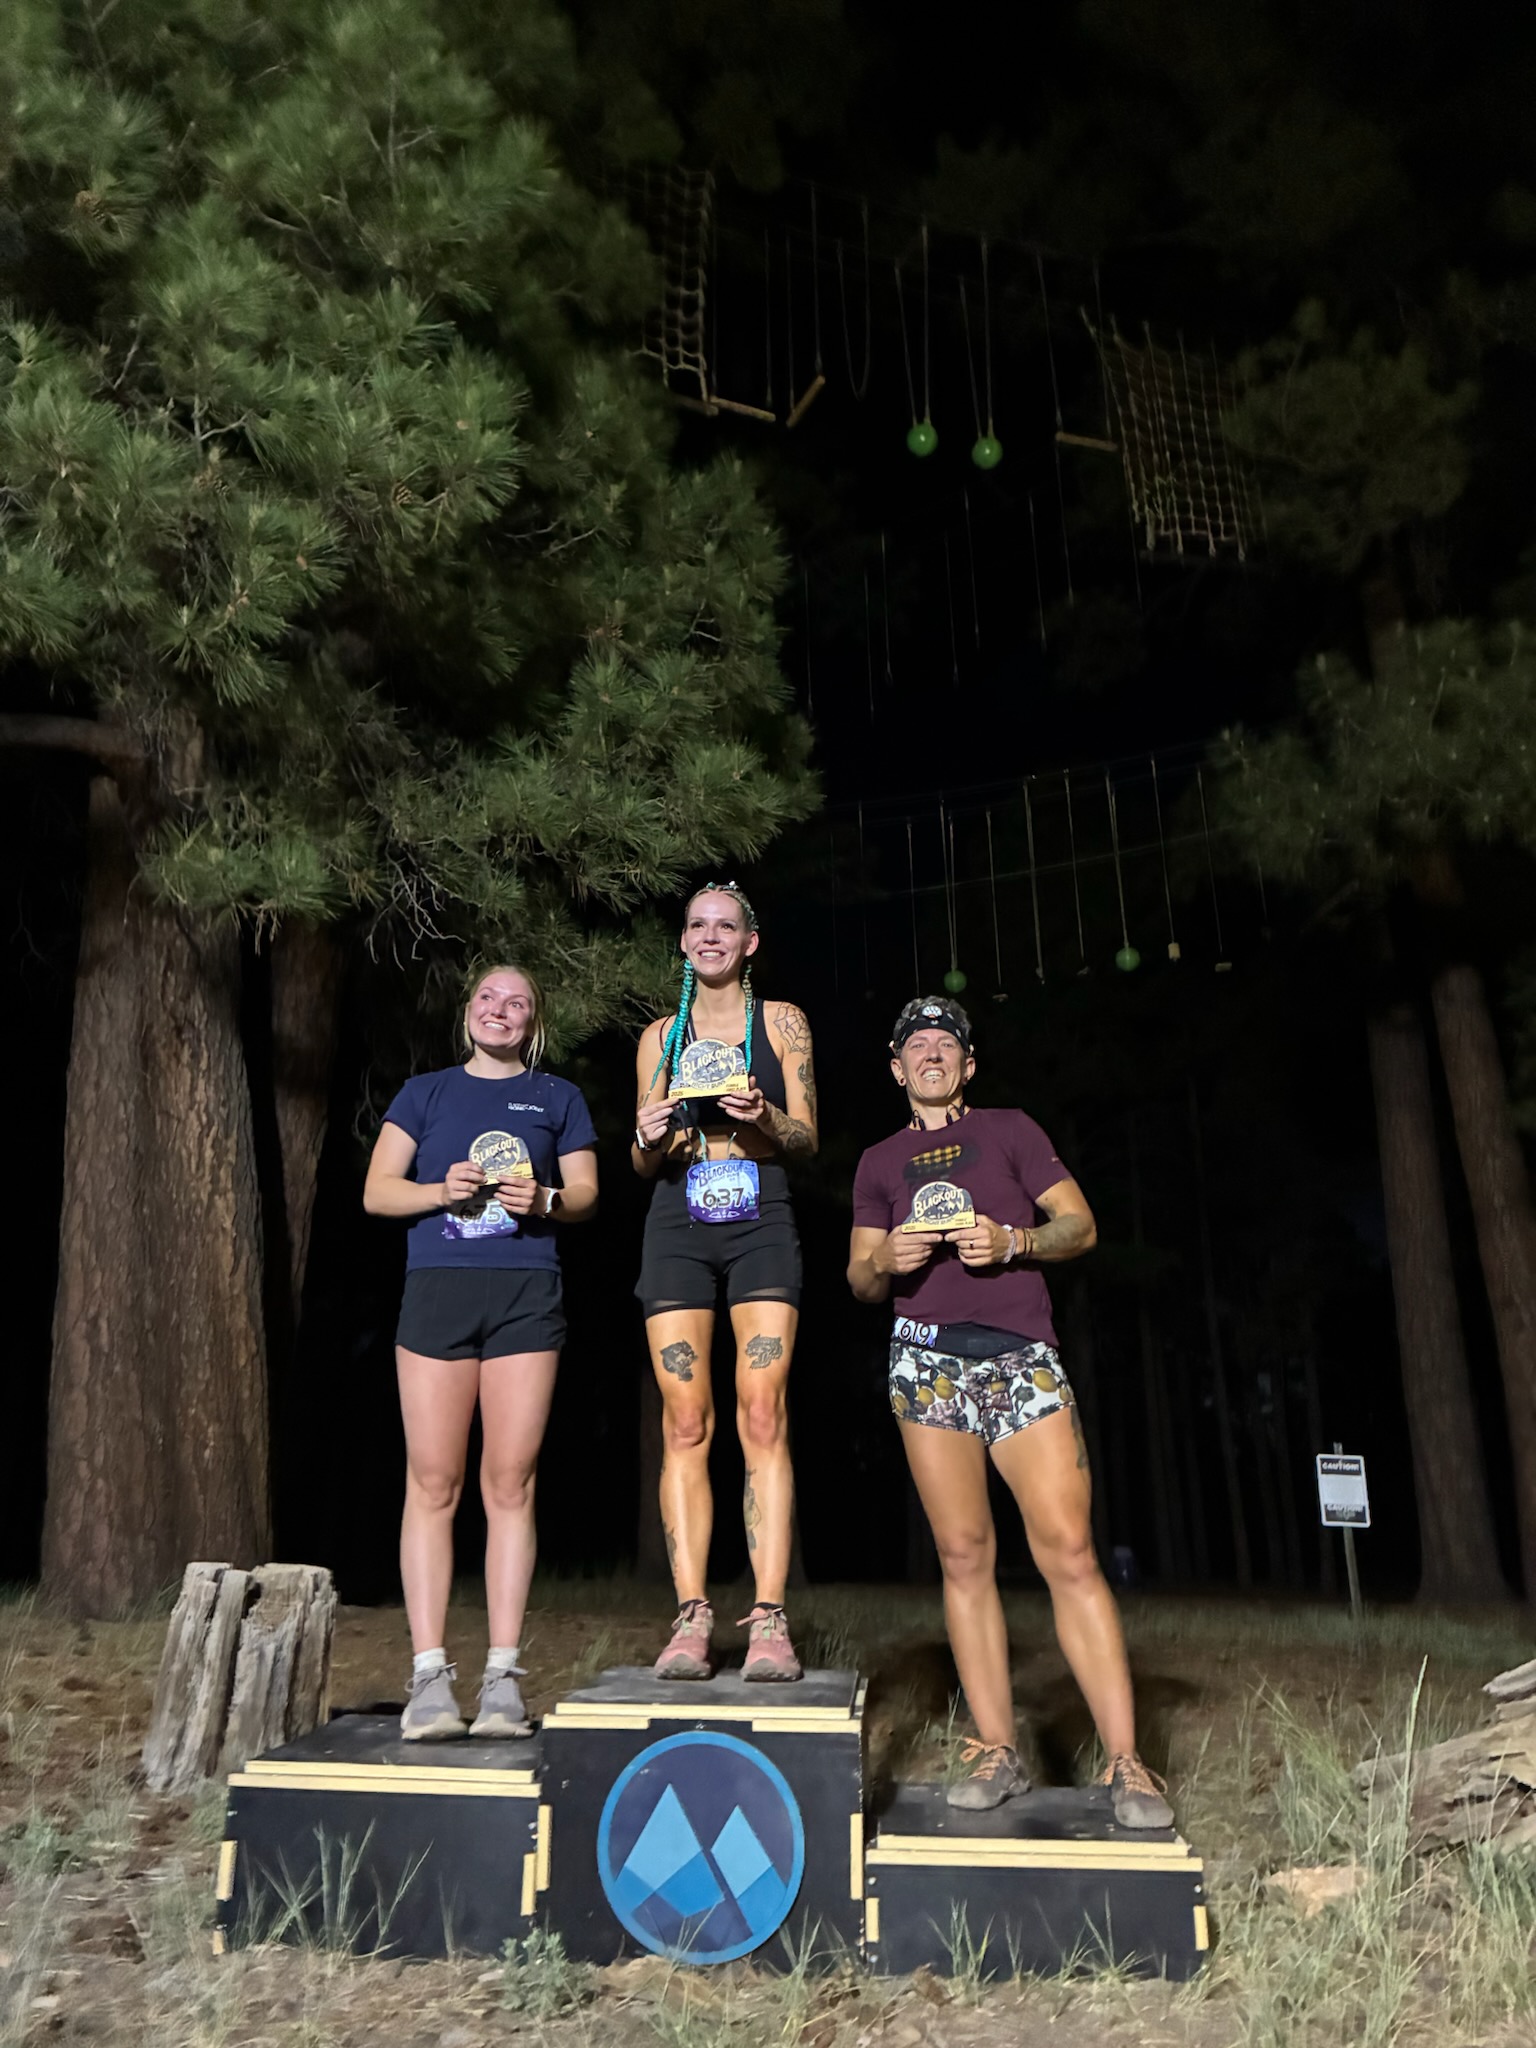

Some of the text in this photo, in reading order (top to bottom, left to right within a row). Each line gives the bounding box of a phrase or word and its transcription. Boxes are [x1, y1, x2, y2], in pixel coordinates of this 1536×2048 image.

[682, 1048, 734, 1082] BLACKOUT
[698, 1163, 744, 1187] BLACKOUT
[702, 1187, 745, 1208] 637
[913, 1188, 963, 1219] BLACKOUT
[900, 1319, 932, 1345] 619
[1322, 1461, 1360, 1471] CAUTION!
